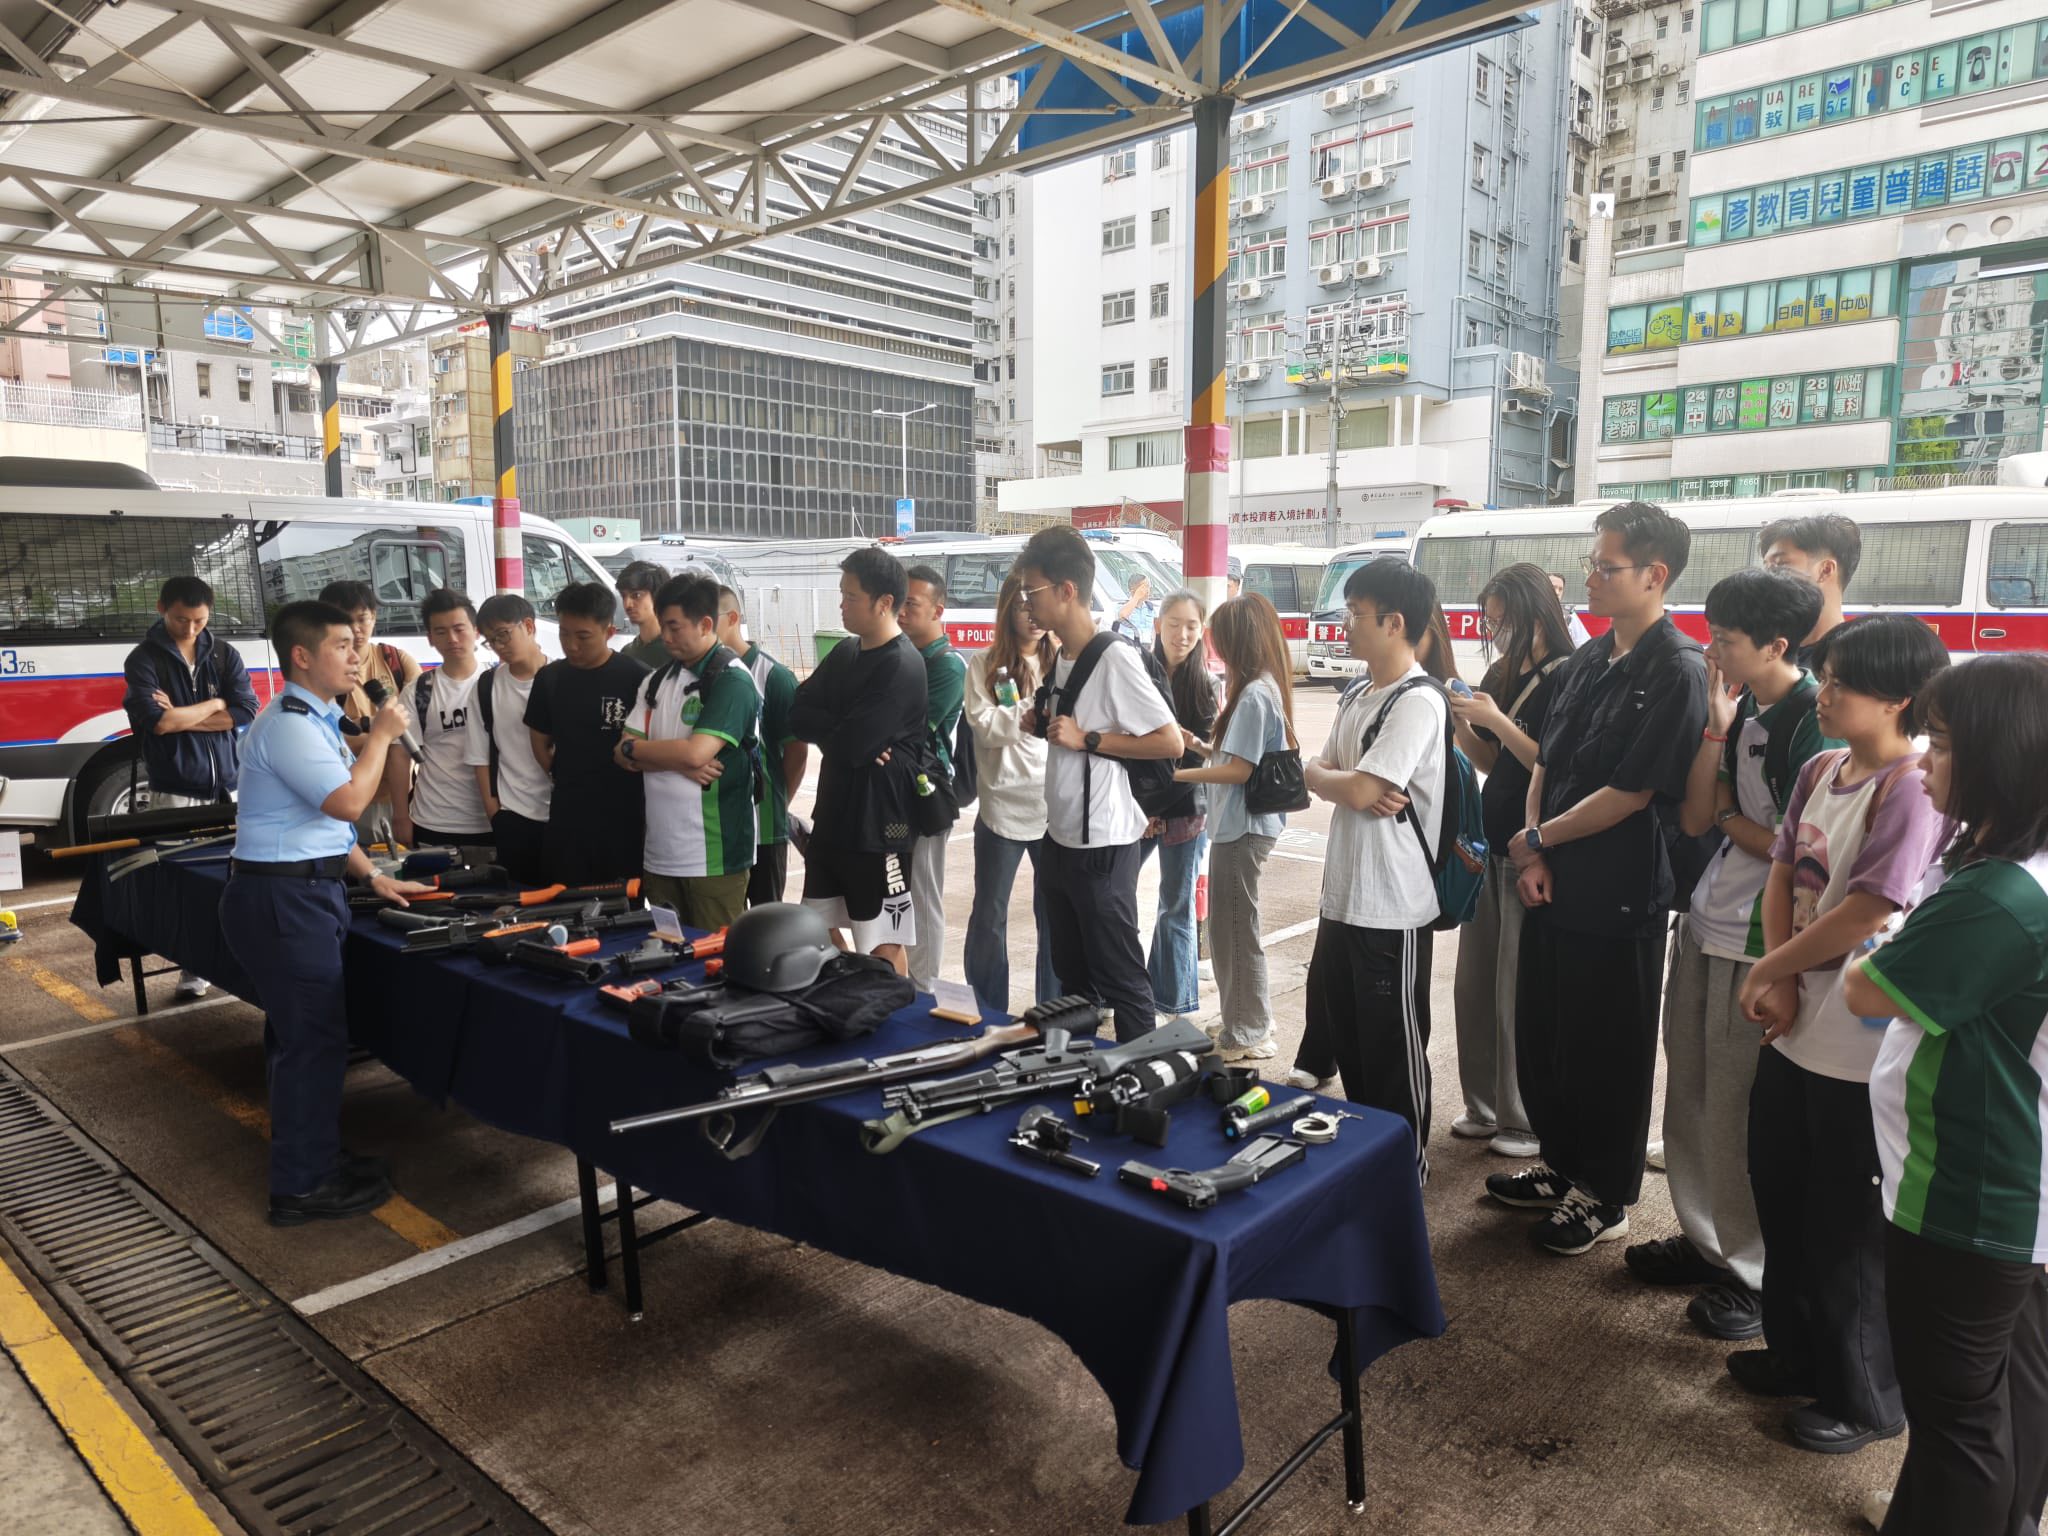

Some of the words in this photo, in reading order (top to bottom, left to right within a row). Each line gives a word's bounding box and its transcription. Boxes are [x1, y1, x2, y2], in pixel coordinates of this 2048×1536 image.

[1727, 154, 1983, 232] 彥教育兒童普通話
[0, 650, 17, 674] 3
[19, 661, 35, 673] 26
